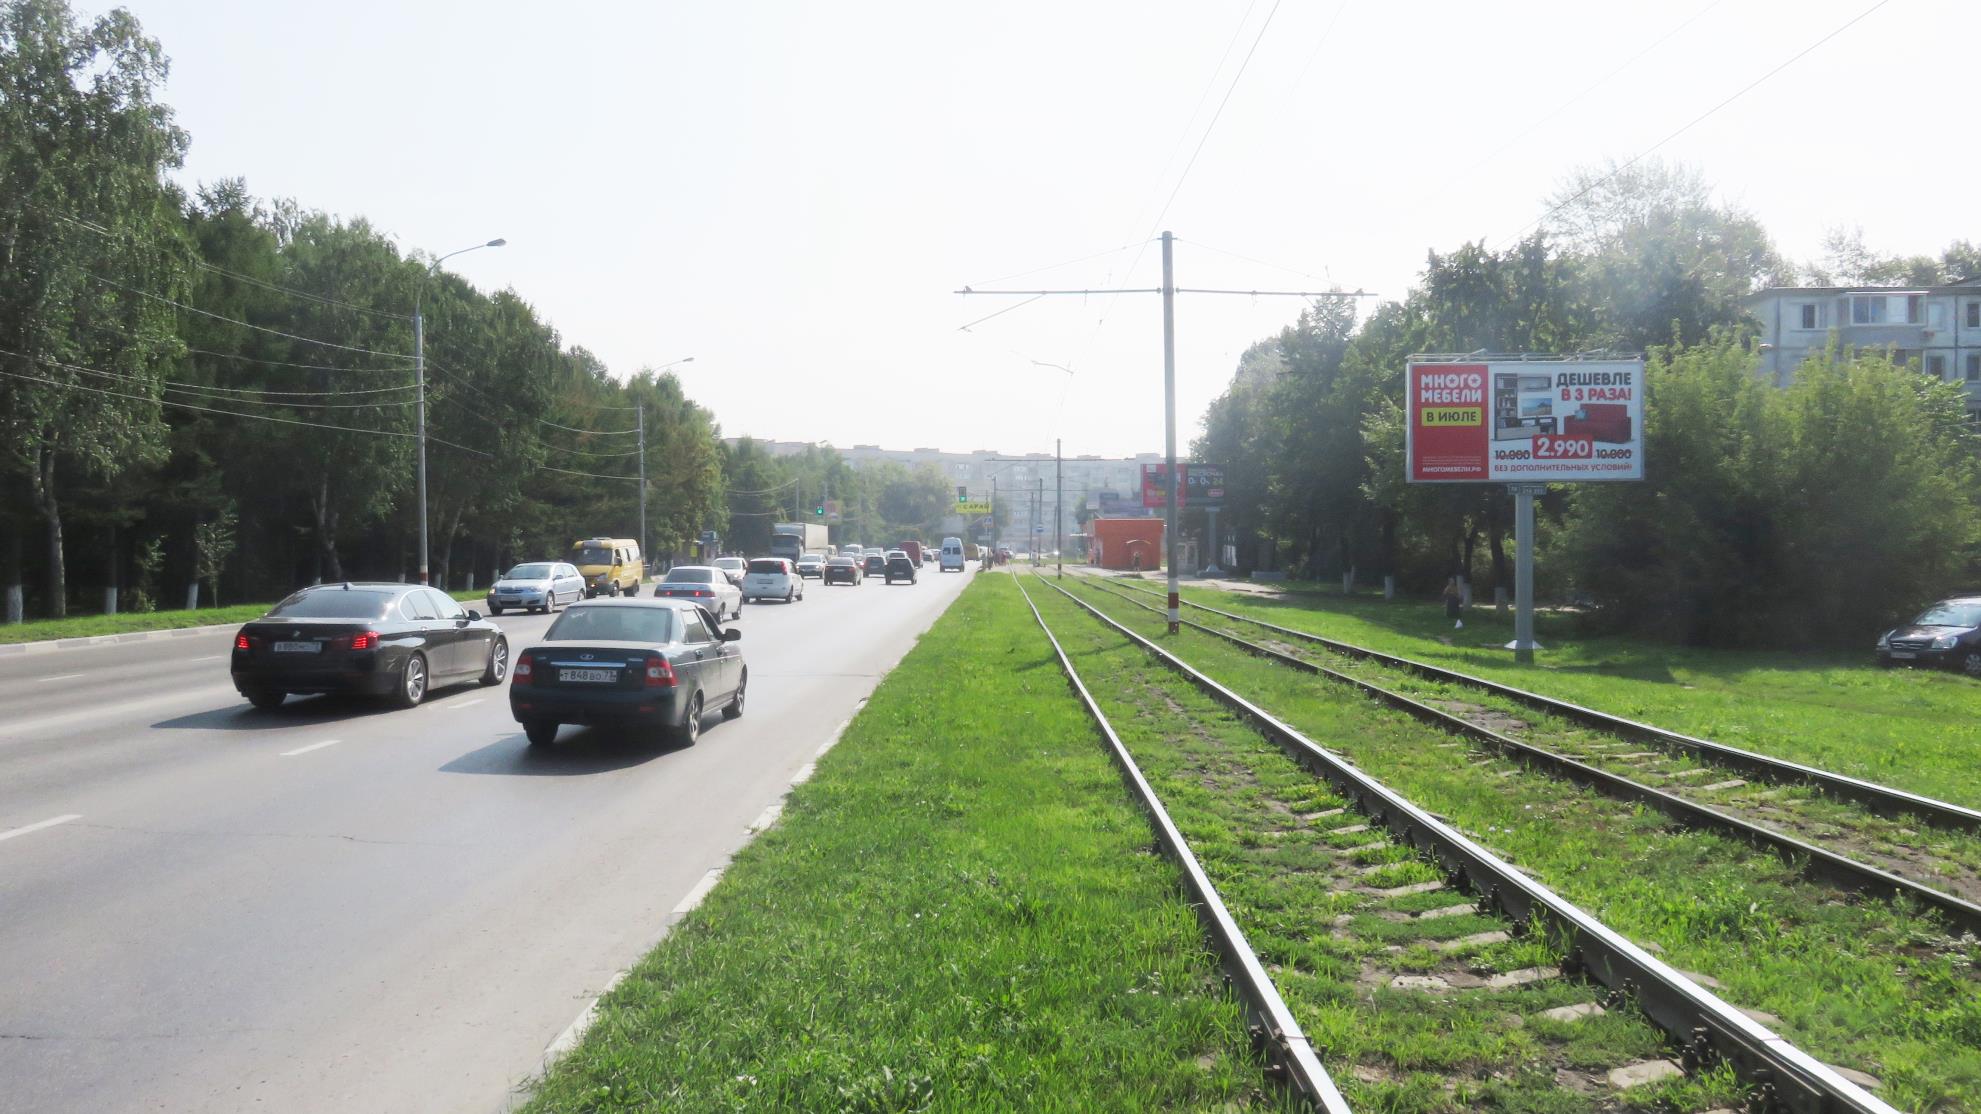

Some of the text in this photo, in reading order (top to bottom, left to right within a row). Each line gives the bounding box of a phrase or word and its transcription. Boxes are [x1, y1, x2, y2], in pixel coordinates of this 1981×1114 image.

[1421, 374, 1482, 388] МНОГО
[1556, 372, 1632, 388] ДЕШЕВЛЕ
[1421, 389, 1482, 403] МЕБЕЛИ
[1561, 388, 1632, 401] В 3 РАЗА!
[1426, 412, 1476, 422] В ИЮЛЕ
[1537, 437, 1589, 457] 2.990
[1494, 464, 1508, 472] БЕЗ
[1510, 463, 1590, 472] ДОПОЛНИТЕЛЬНЫХ
